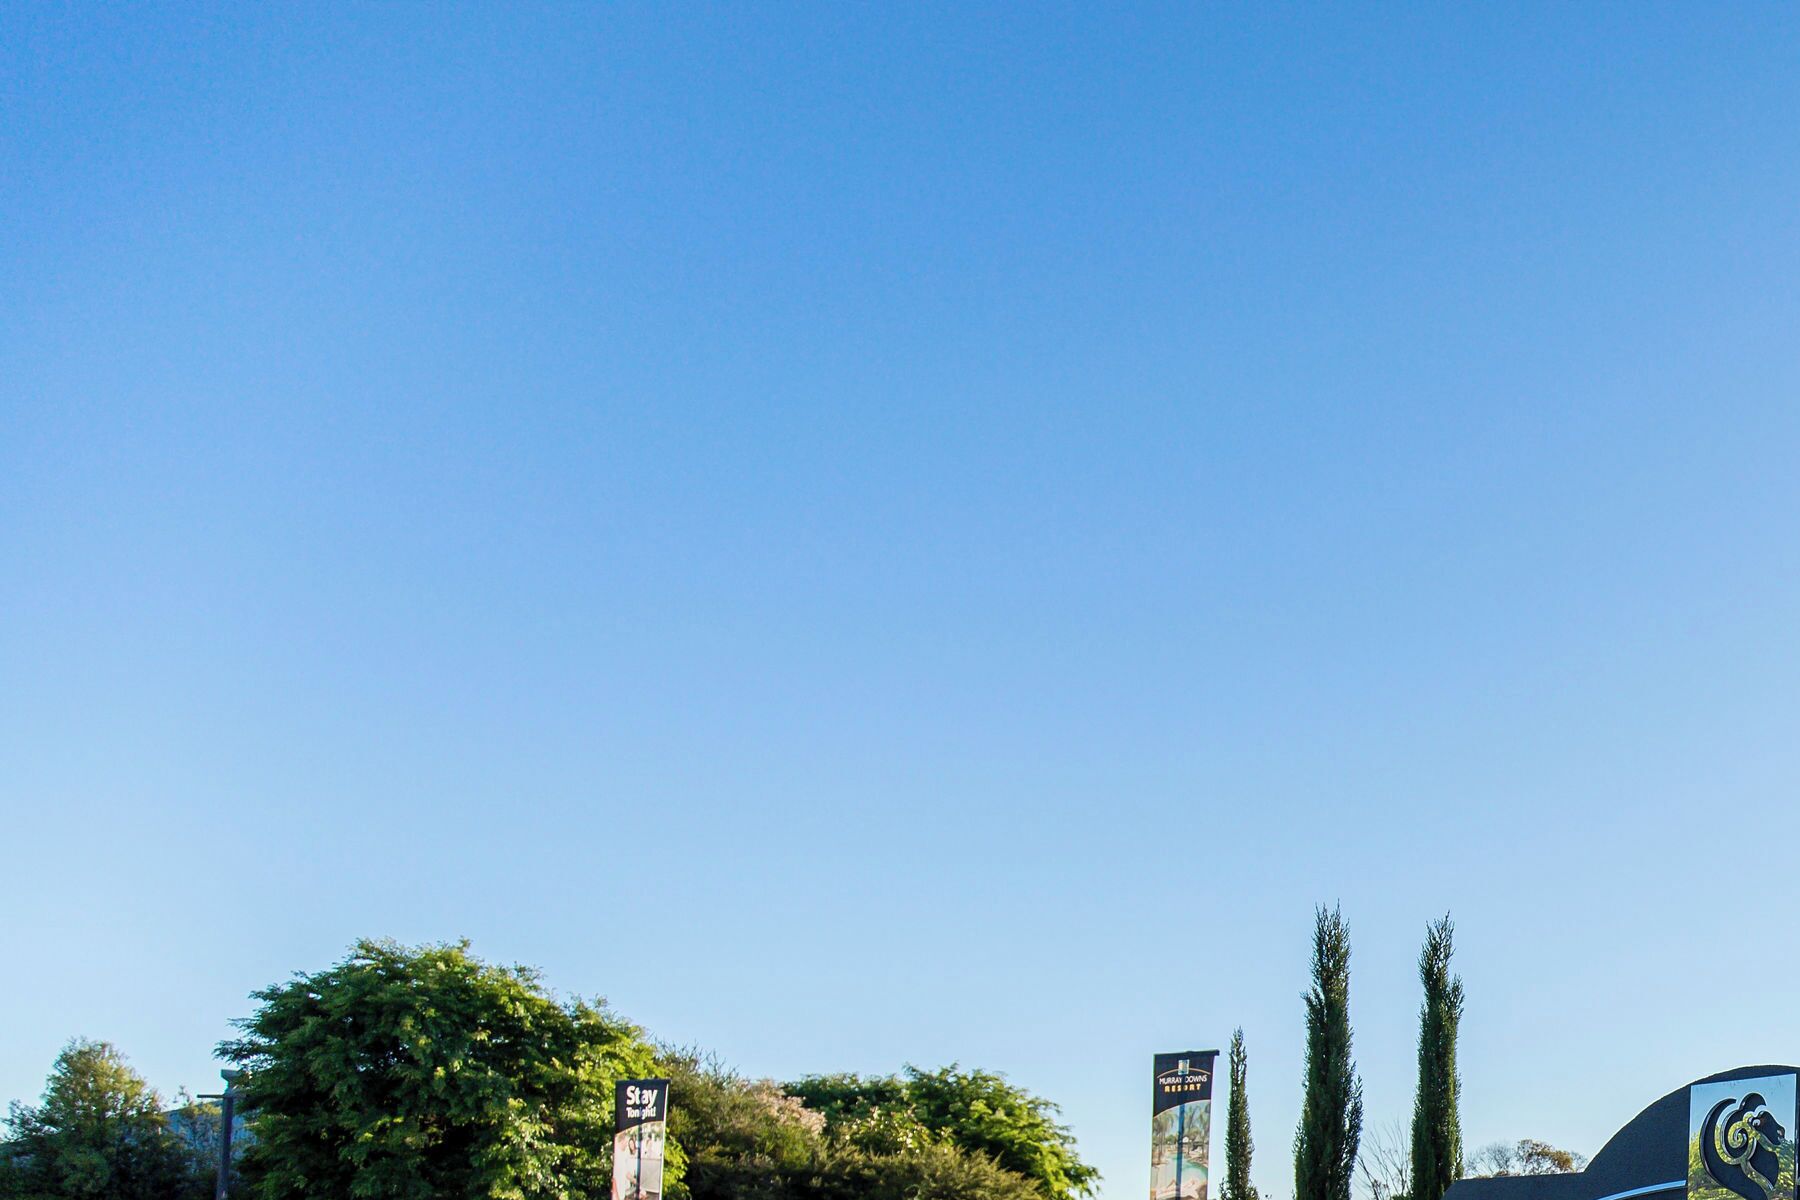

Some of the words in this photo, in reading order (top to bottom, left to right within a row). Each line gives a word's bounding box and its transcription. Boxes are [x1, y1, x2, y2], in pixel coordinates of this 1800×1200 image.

[1159, 1077, 1183, 1085] MURRAY
[1164, 1083, 1201, 1093] RESORT
[626, 1085, 658, 1109] Stay
